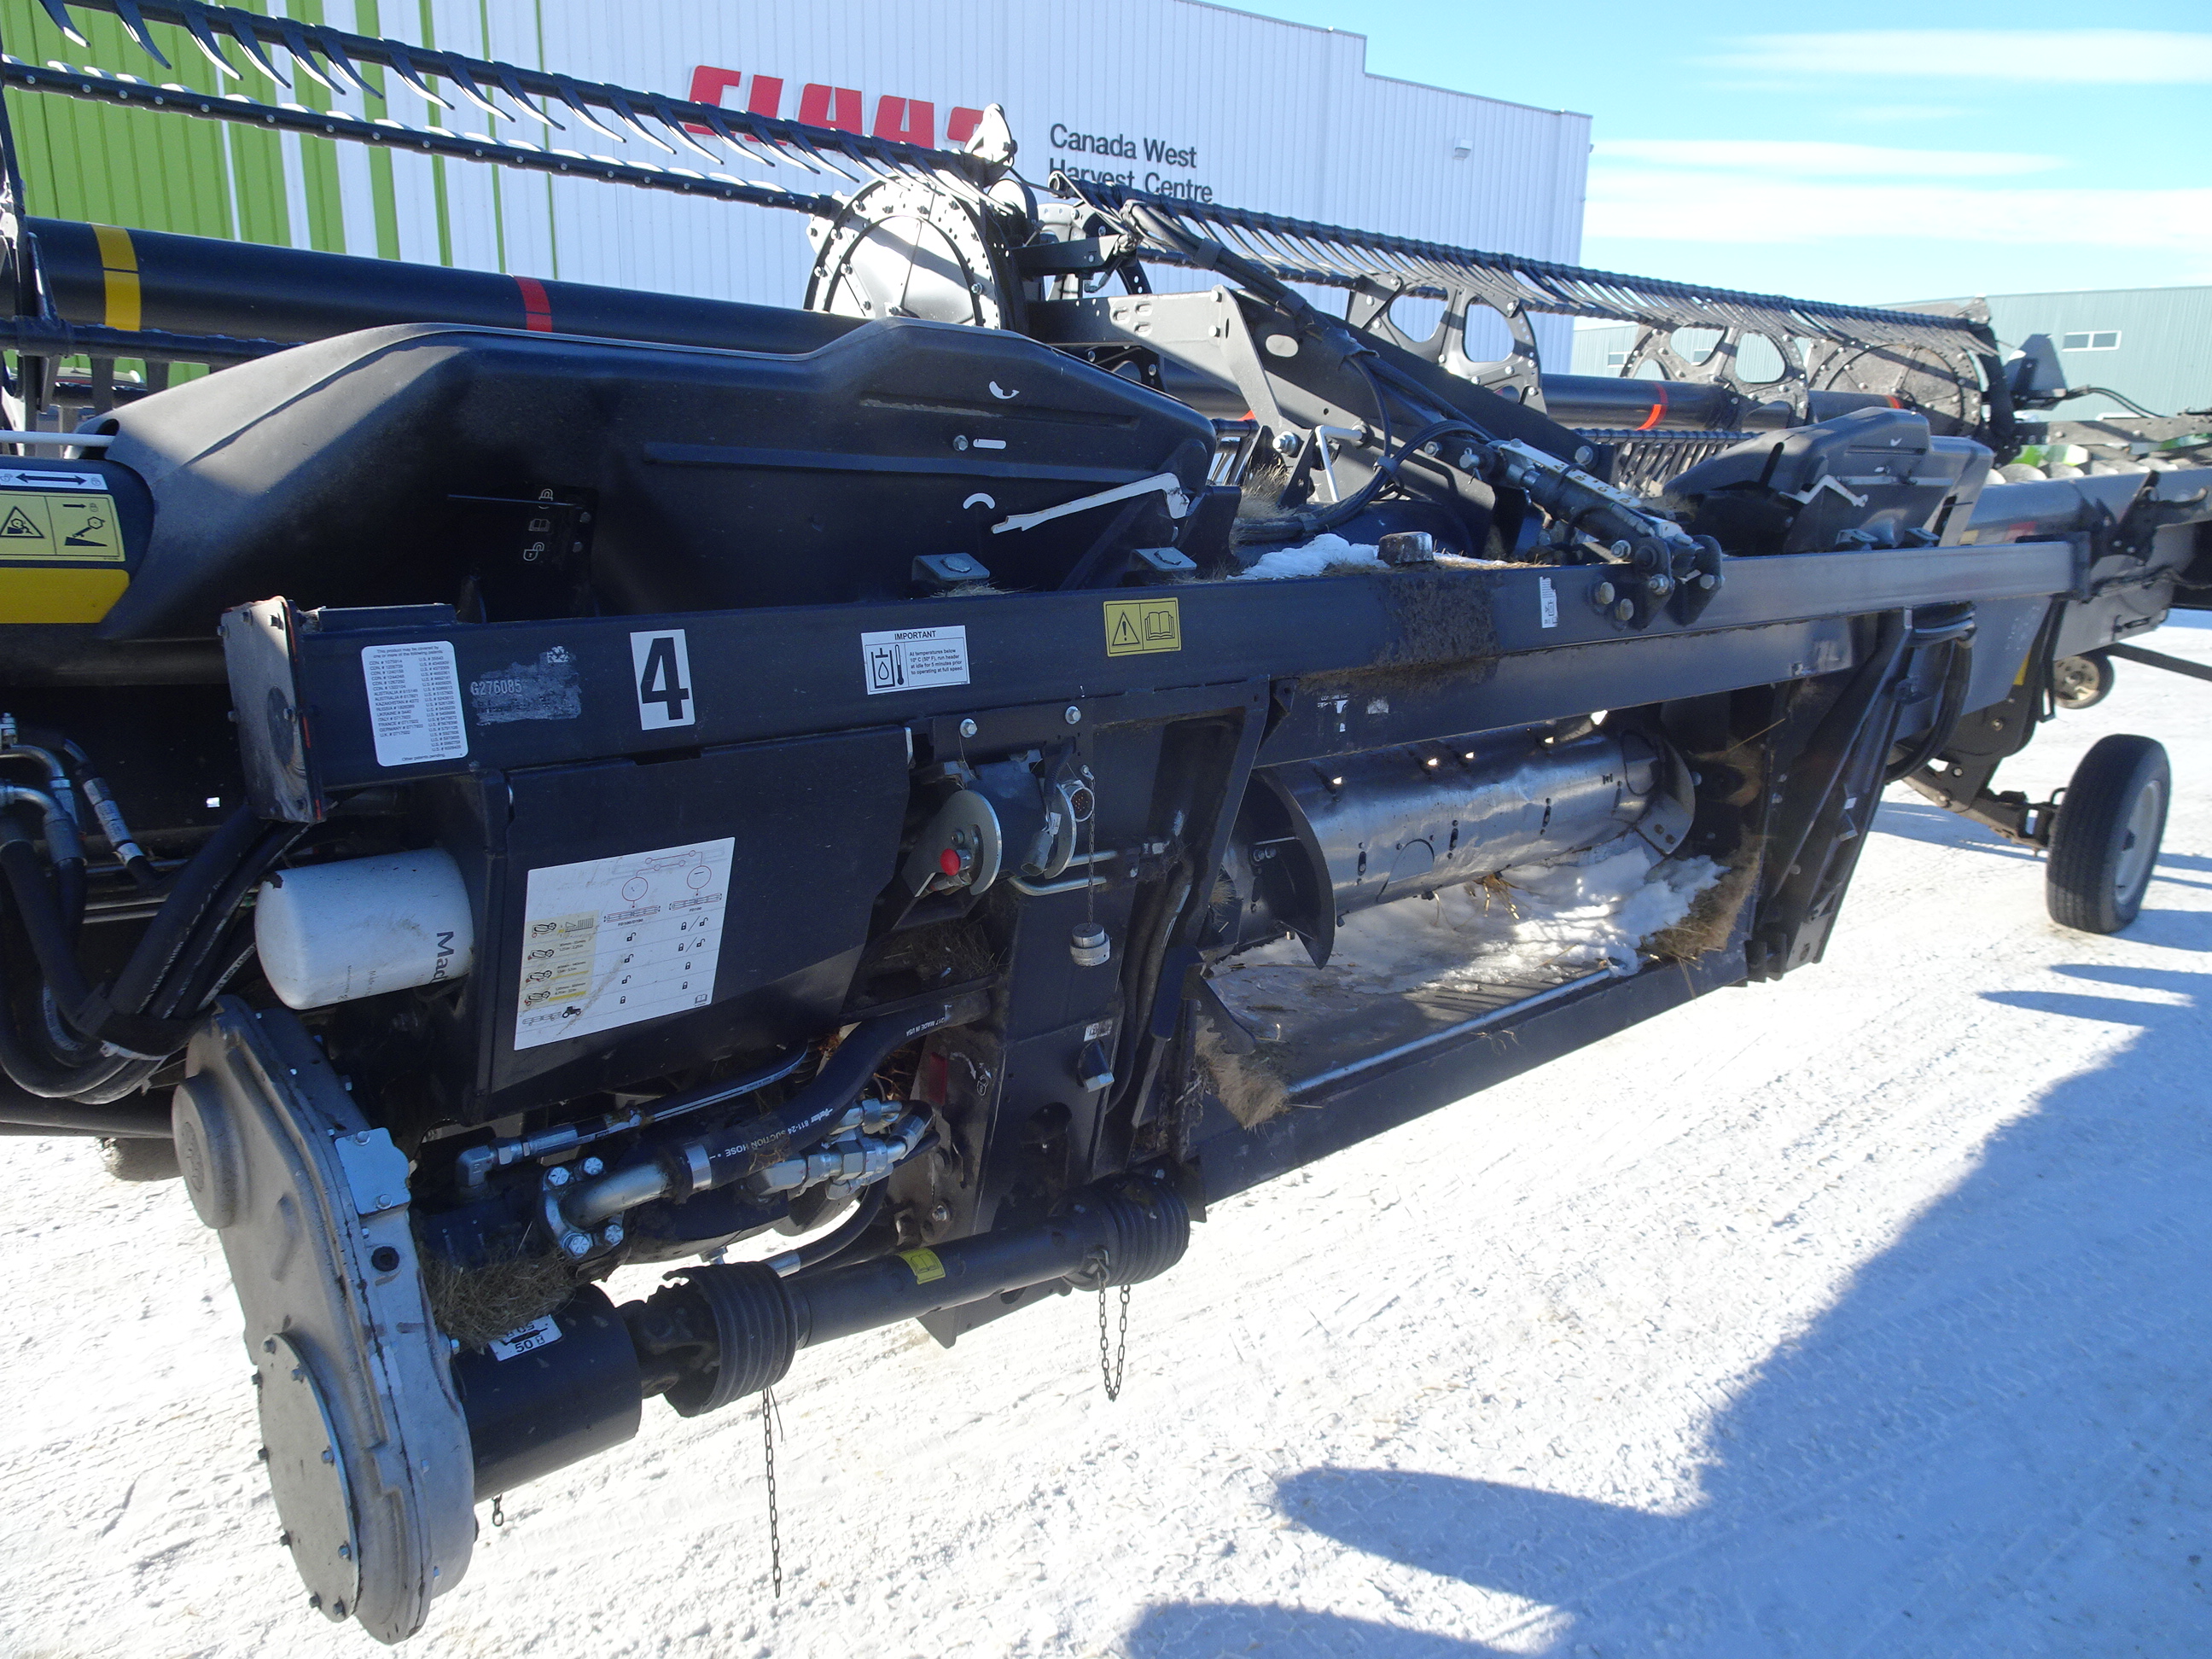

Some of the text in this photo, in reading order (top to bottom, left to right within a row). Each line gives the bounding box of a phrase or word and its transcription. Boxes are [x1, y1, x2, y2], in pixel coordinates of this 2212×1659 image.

[1050, 123, 1197, 169] Canada West
[1144, 172, 1213, 203] Centre
[894, 630, 936, 640] IMPORTANT
[640, 637, 690, 721] 4
[469, 678, 522, 696] G276085
[906, 1027, 915, 1037] USA
[921, 1021, 935, 1031] MADE
[787, 1120, 809, 1135] 811-24
[724, 1144, 749, 1157] HOSE
[515, 1339, 534, 1353] 50
